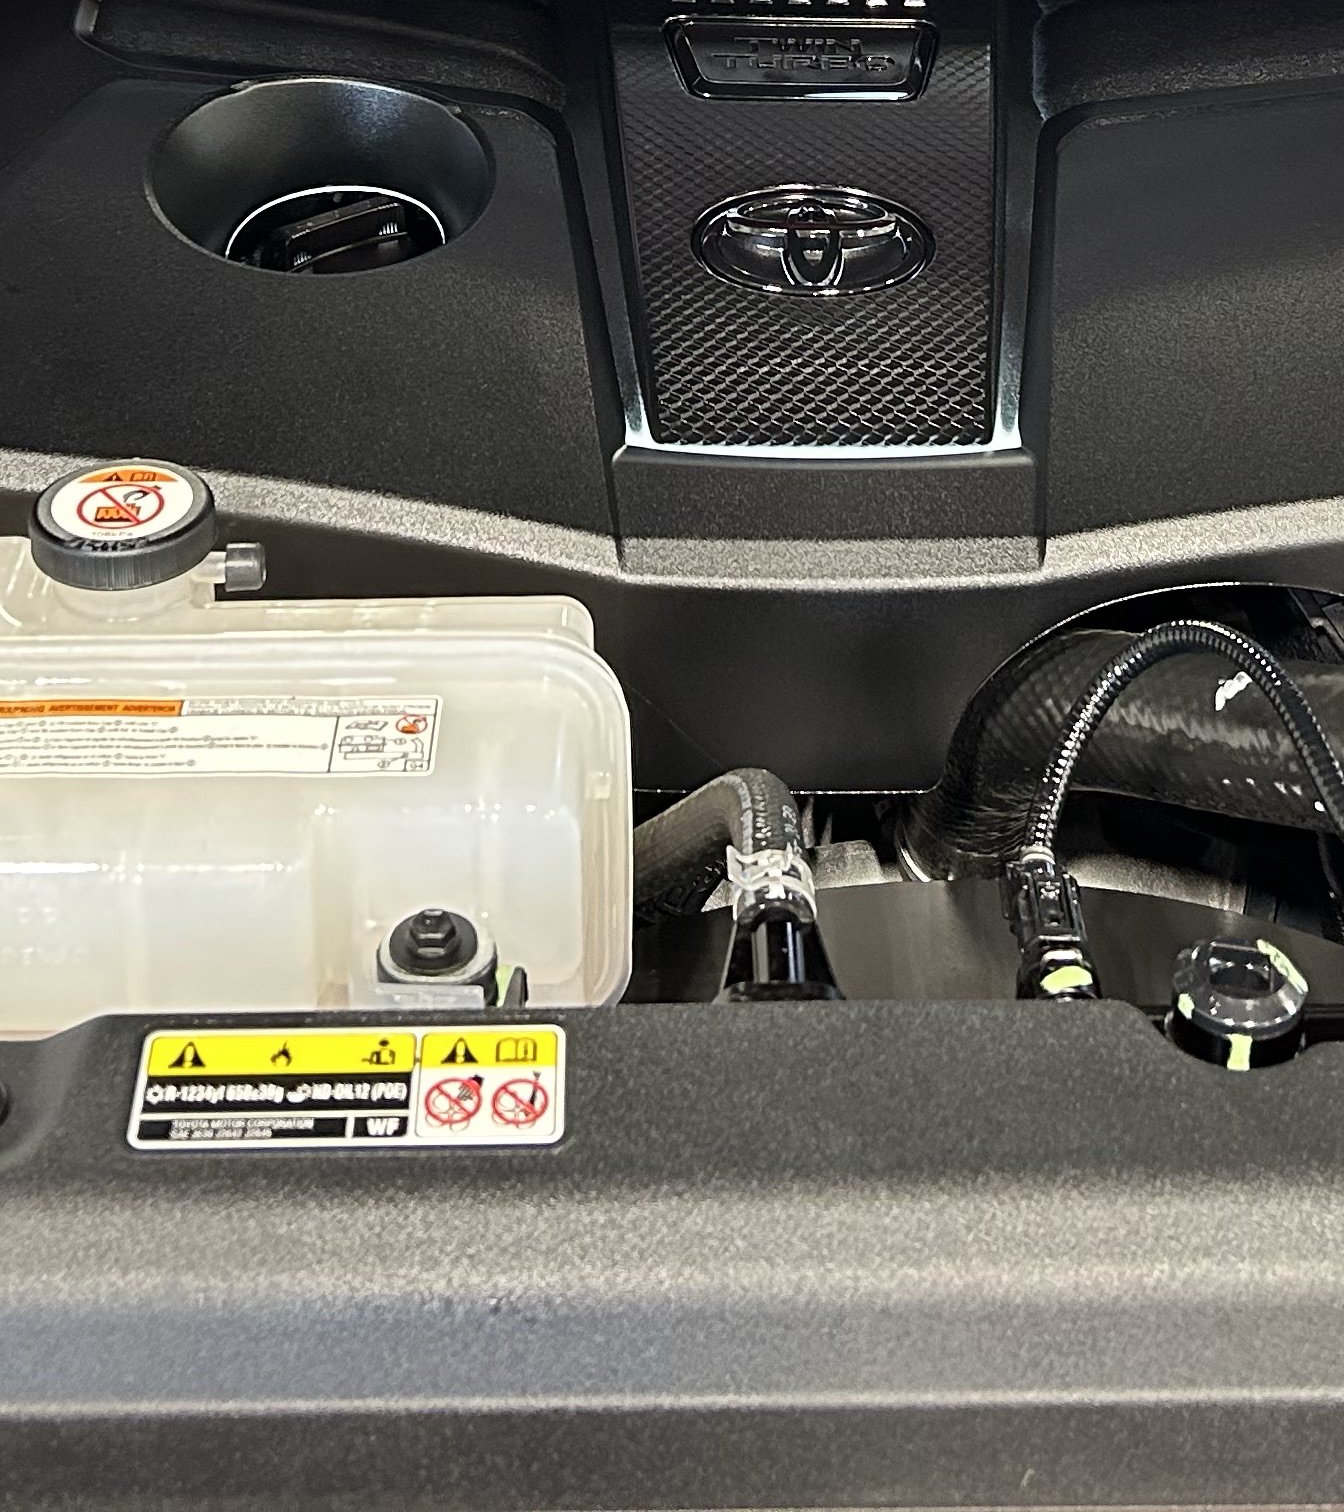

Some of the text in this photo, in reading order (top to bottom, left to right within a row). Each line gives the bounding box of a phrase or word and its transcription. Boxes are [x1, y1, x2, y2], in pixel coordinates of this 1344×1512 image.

[734, 36, 861, 52] TWIN
[711, 53, 896, 72] TURBO
[366, 1117, 401, 1136] WF
